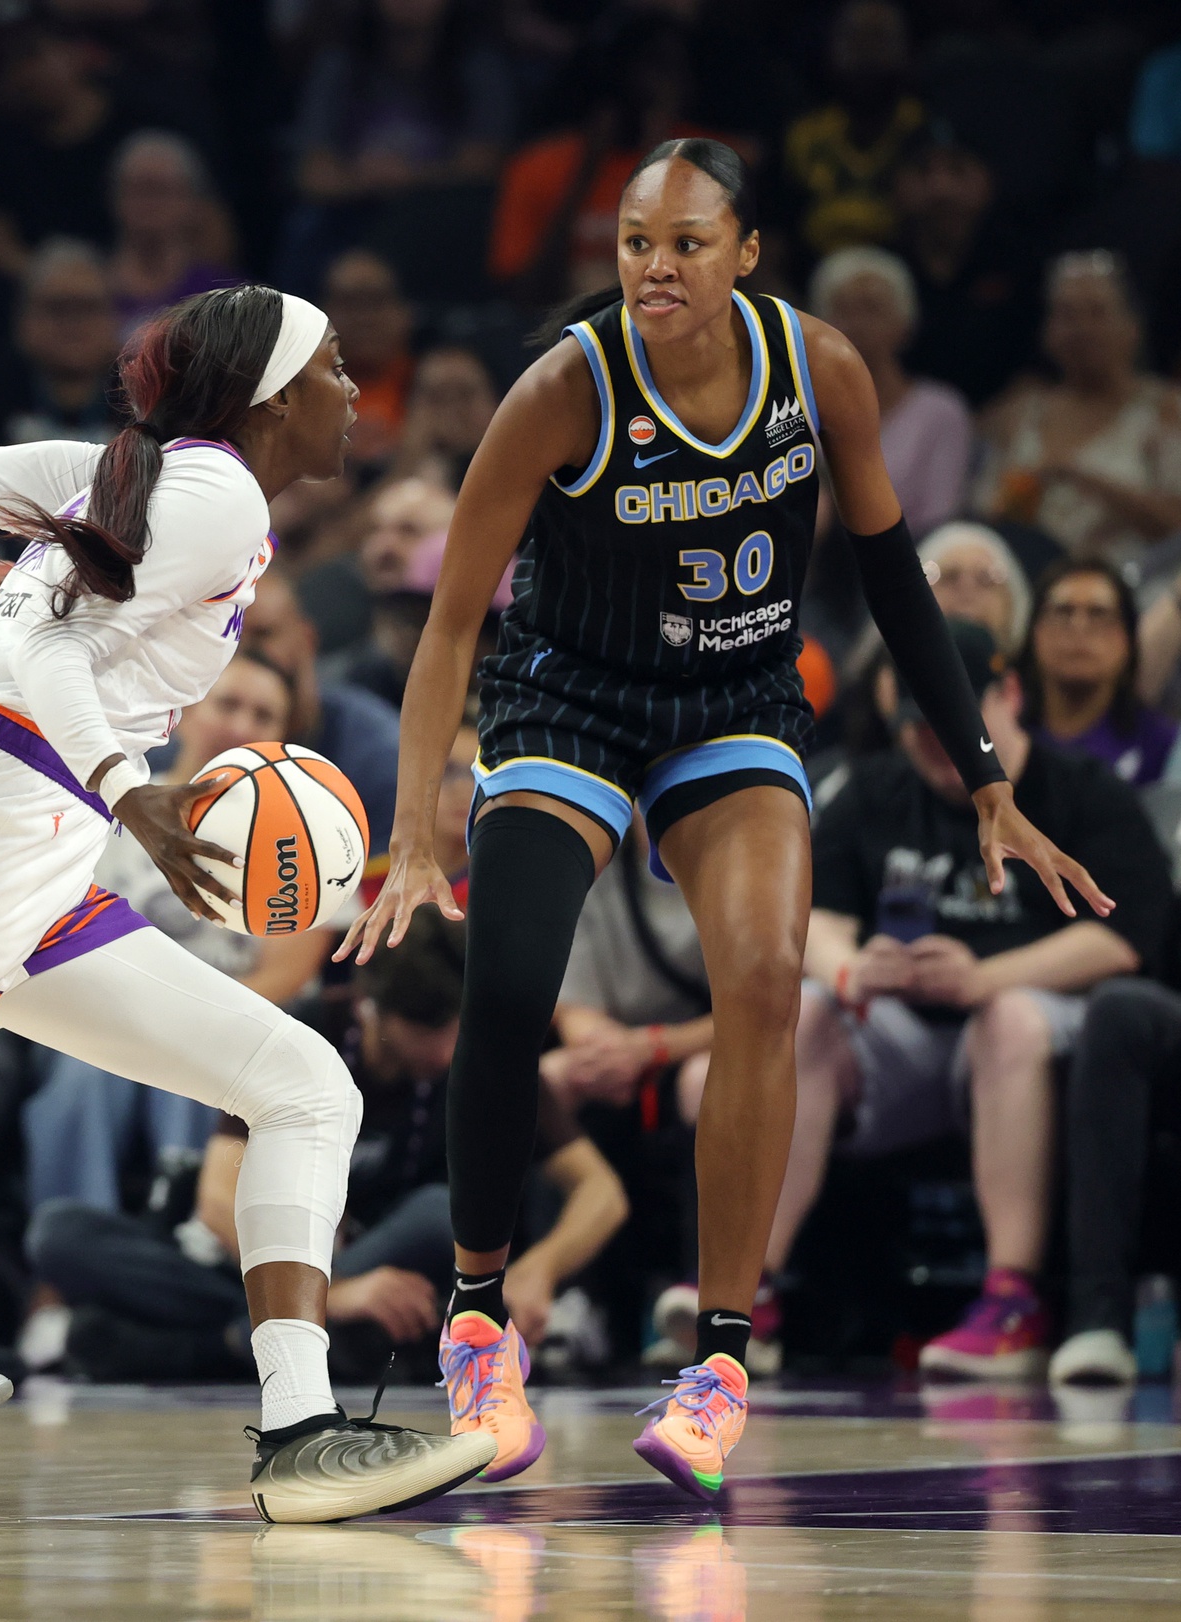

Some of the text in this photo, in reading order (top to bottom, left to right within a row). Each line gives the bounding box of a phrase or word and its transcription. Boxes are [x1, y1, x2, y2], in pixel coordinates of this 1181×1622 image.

[615, 443, 815, 524] CHICAGO
[677, 530, 774, 602] 30
[698, 617, 792, 652] Medicine
[700, 599, 792, 633] UChicago
[265, 834, 300, 936] Wilson
